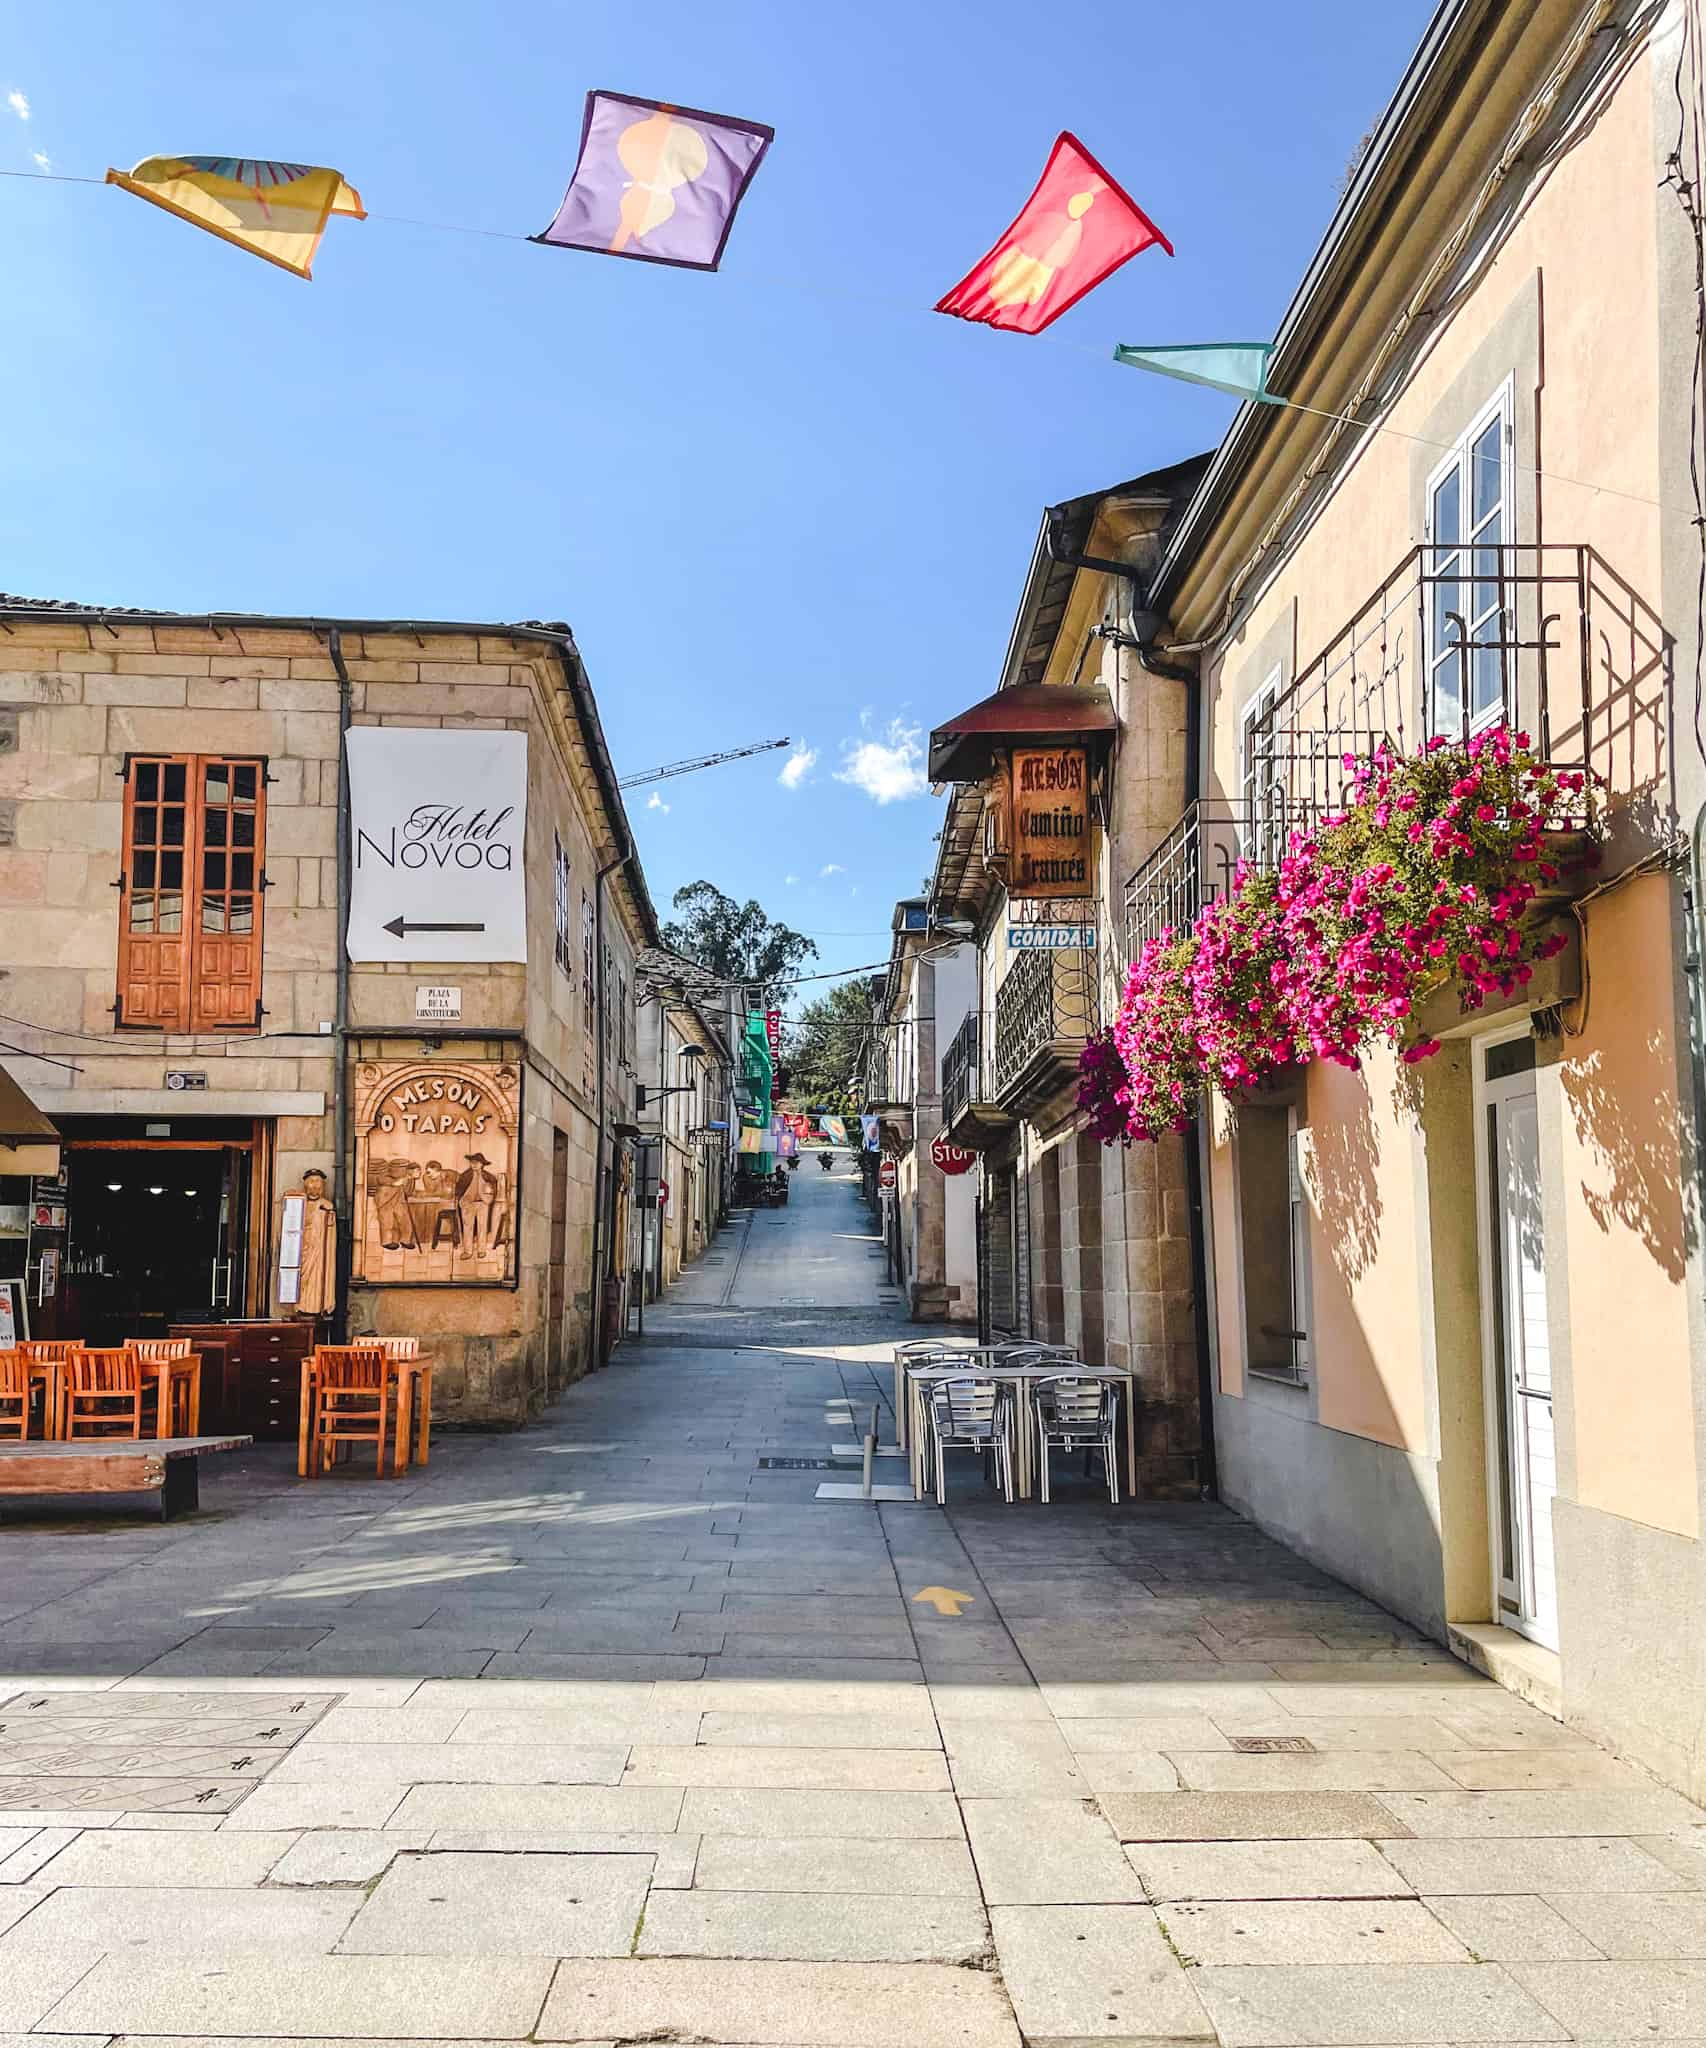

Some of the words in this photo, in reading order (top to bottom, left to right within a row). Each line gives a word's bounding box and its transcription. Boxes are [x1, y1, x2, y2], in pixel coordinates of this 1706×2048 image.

[1020, 751, 1084, 792] MESÓN
[403, 804, 514, 842] Hotel
[357, 827, 511, 871] Novoa
[1020, 850, 1086, 883] Francés
[1012, 930, 1091, 946] COMIDAS
[428, 989, 450, 998] PLAZA
[428, 1000, 438, 1008] DE
[440, 1000, 449, 1008] LA
[392, 1078, 481, 1112] MESÓN
[380, 1114, 395, 1133] O
[402, 1114, 487, 1134] TAPAS
